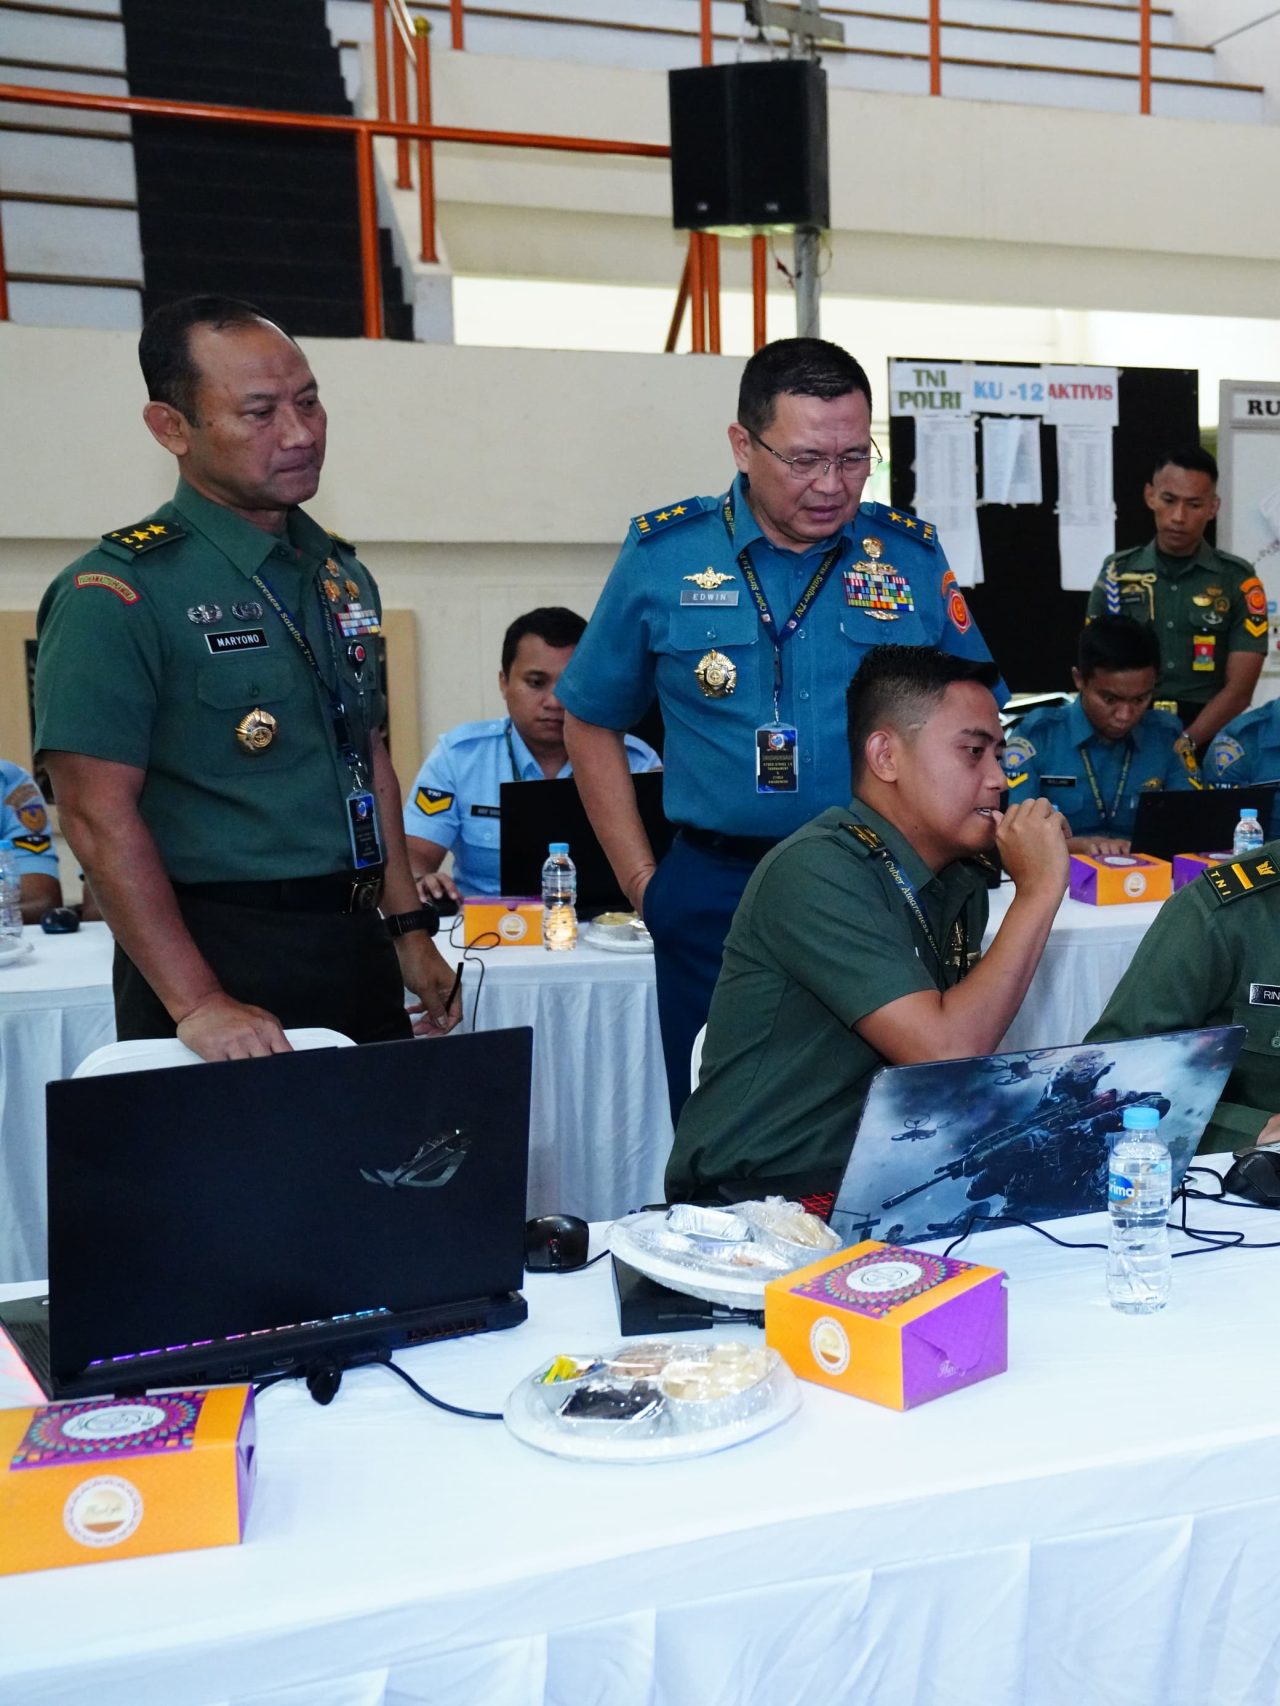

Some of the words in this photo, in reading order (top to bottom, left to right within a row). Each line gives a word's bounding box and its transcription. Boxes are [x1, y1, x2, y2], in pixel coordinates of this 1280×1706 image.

[912, 369, 947, 388] TNI
[974, 381, 1003, 399] KU
[1009, 382, 1044, 401] -12
[1047, 383, 1114, 400] AKTIVIS
[899, 391, 962, 410] POLRI
[636, 515, 651, 533] TNI
[923, 523, 935, 540] TNI
[692, 593, 727, 601] EDWIN
[795, 602, 807, 618] TNI
[216, 633, 260, 648] MARYONO
[885, 860, 905, 886] Cyber
[1210, 870, 1231, 896] TNI
[1109, 1181, 1135, 1198] rima
